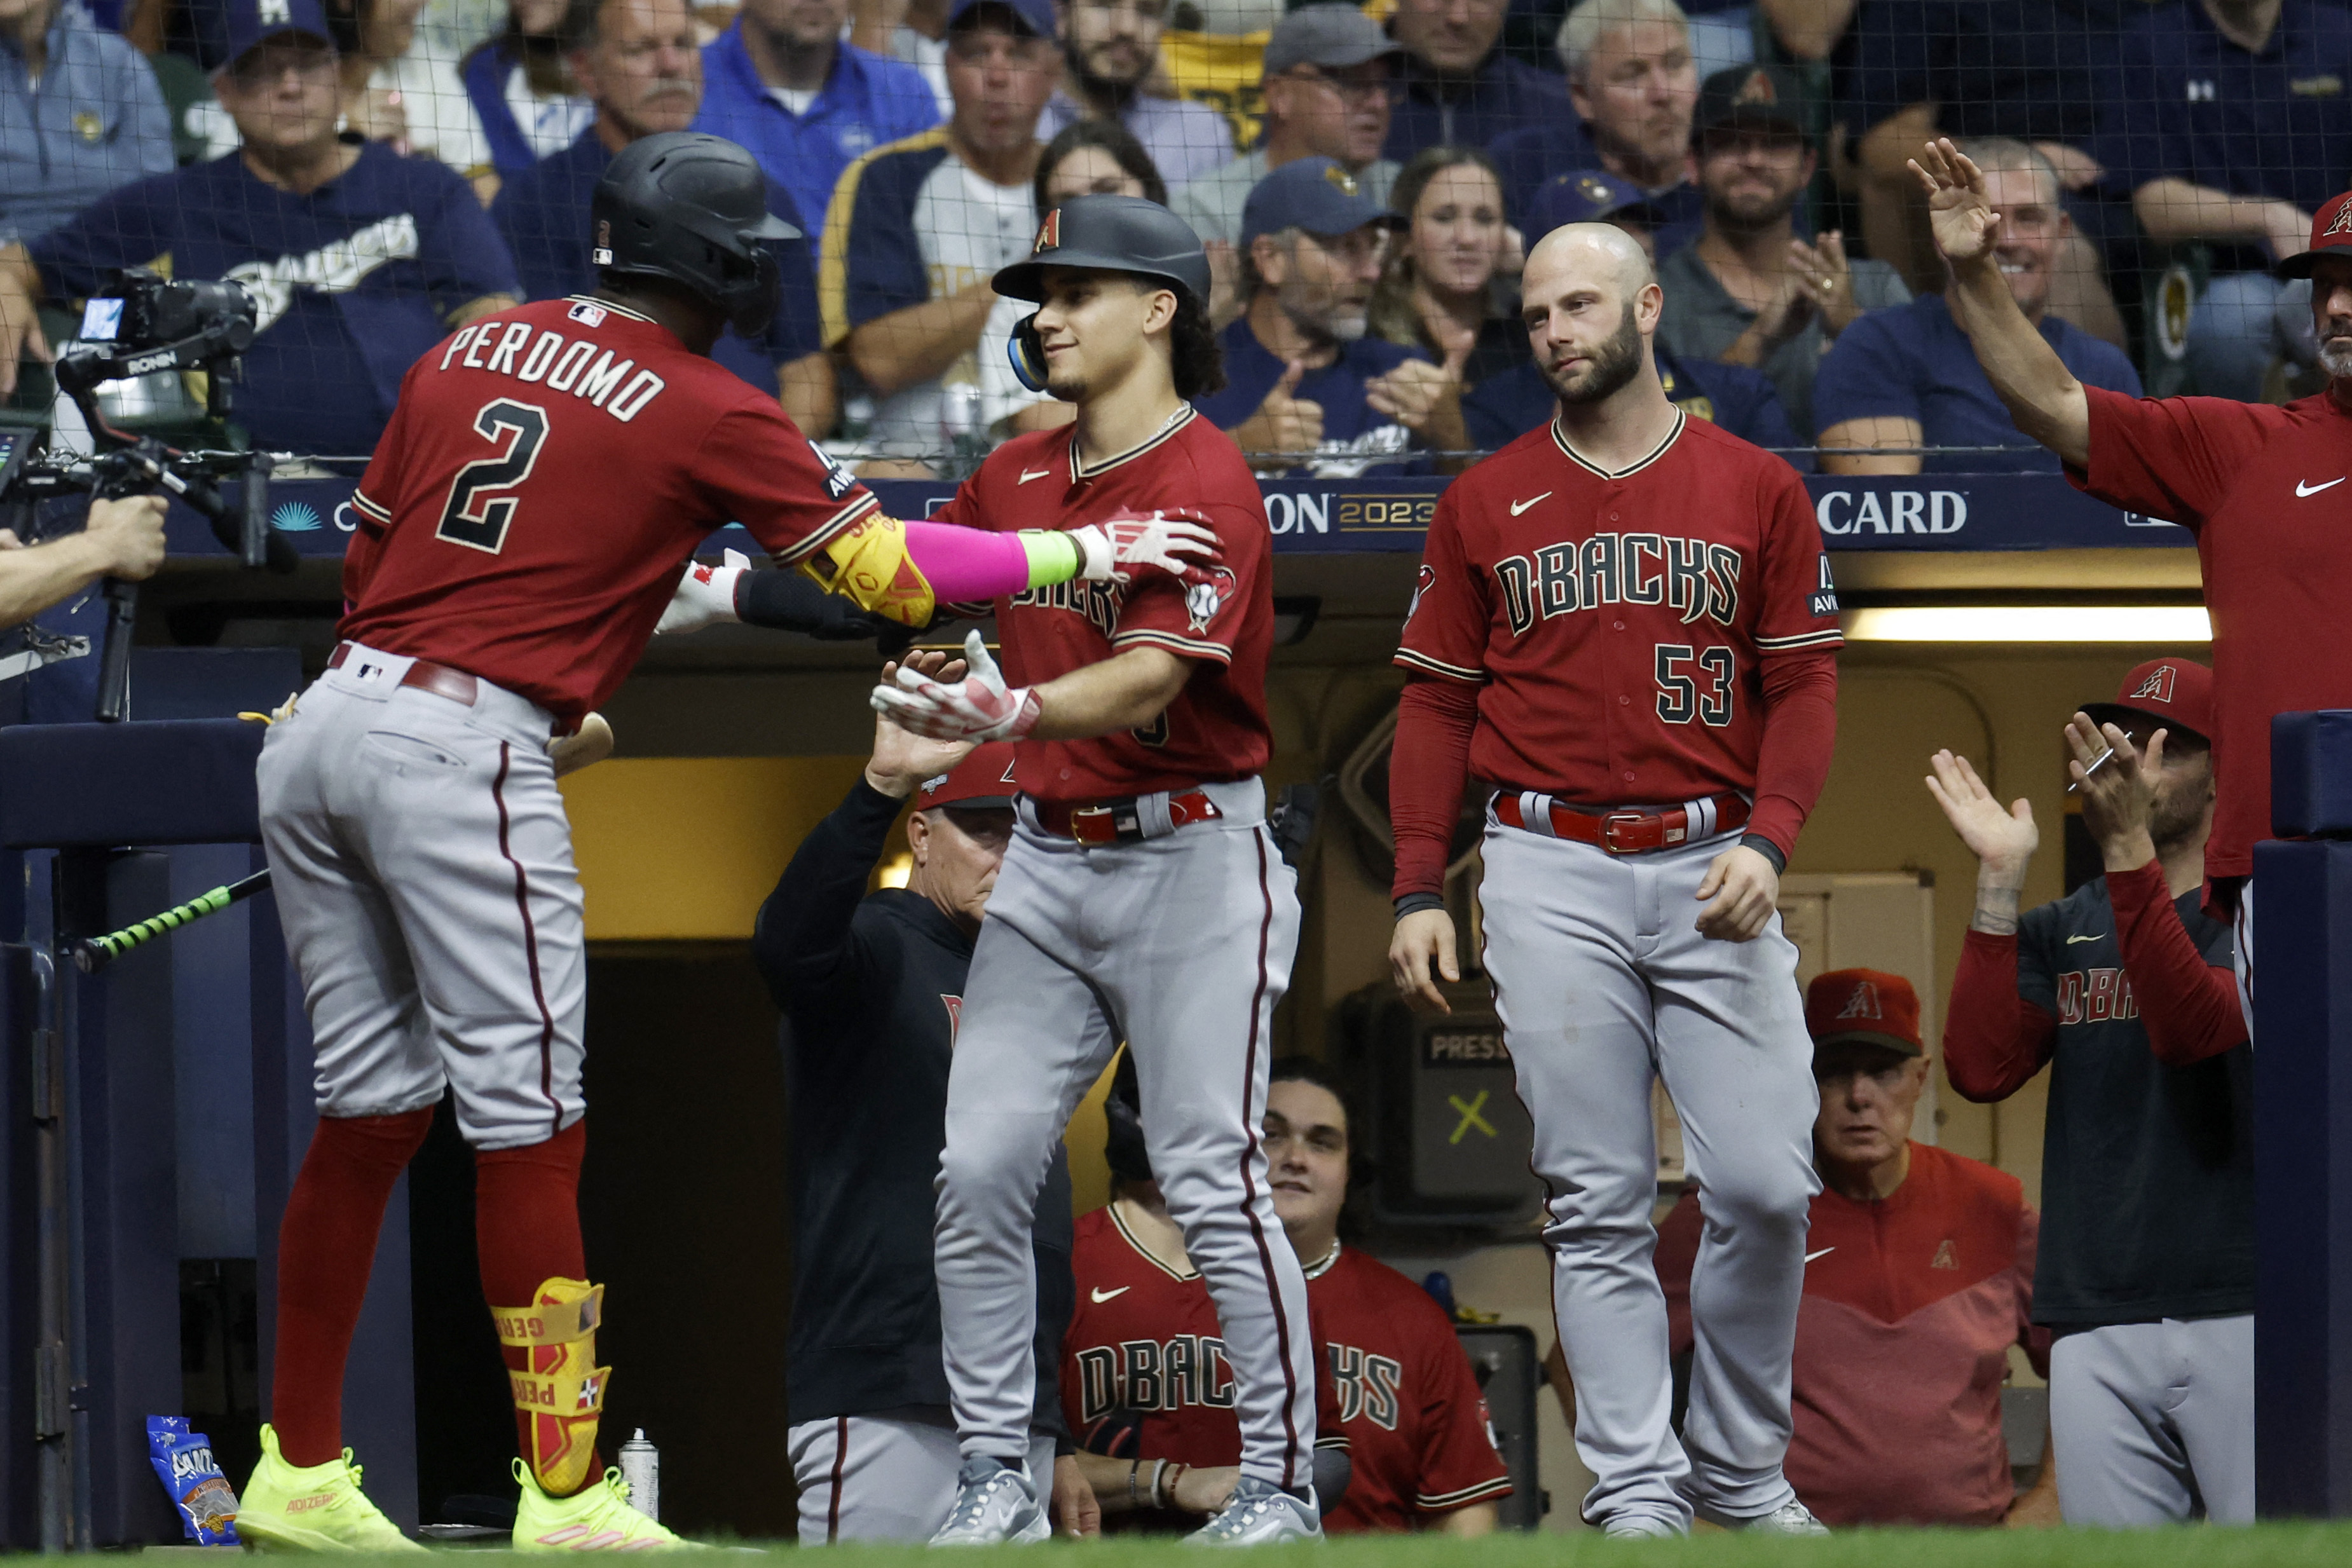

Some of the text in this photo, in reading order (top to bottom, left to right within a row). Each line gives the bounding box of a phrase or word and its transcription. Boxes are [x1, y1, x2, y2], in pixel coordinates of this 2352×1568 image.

[127, 350, 177, 376] RONIN
[439, 321, 666, 423] PERDOMO
[434, 397, 550, 556] 2
[1339, 501, 1437, 524] 2023
[1816, 491, 1967, 535] CARD
[1654, 643, 1735, 726] 53
